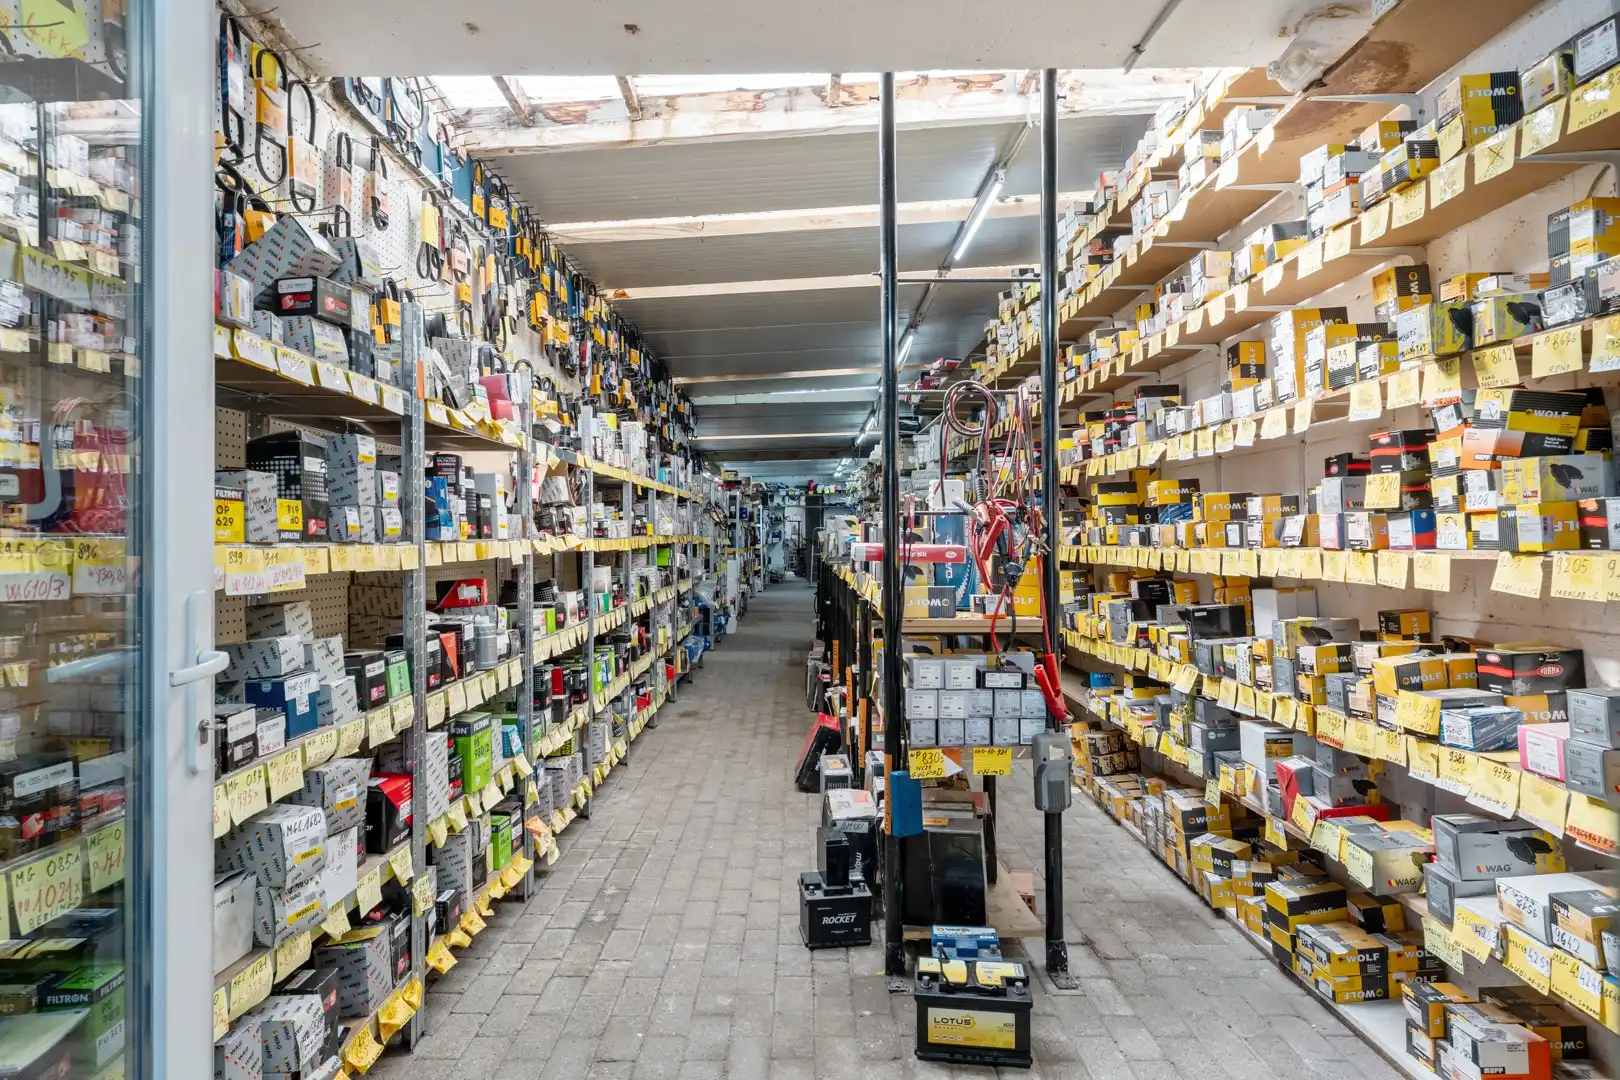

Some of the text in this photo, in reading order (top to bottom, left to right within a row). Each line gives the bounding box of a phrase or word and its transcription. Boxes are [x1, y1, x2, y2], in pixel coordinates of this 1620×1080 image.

[1534, 408, 1570, 419] WOLF
[216, 505, 230, 515] OP
[215, 516, 234, 527] 629
[1410, 672, 1442, 684] WOLF
[1195, 814, 1225, 823] WOLF
[841, 821, 864, 833] BMW
[1308, 907, 1333, 916] WOLF
[821, 914, 857, 925] ROCKET
[1346, 952, 1380, 962] WOLF
[1343, 989, 1376, 999] WOLF
[46, 994, 89, 1005] FILTRON
[934, 1016, 972, 1026] LOTUS
